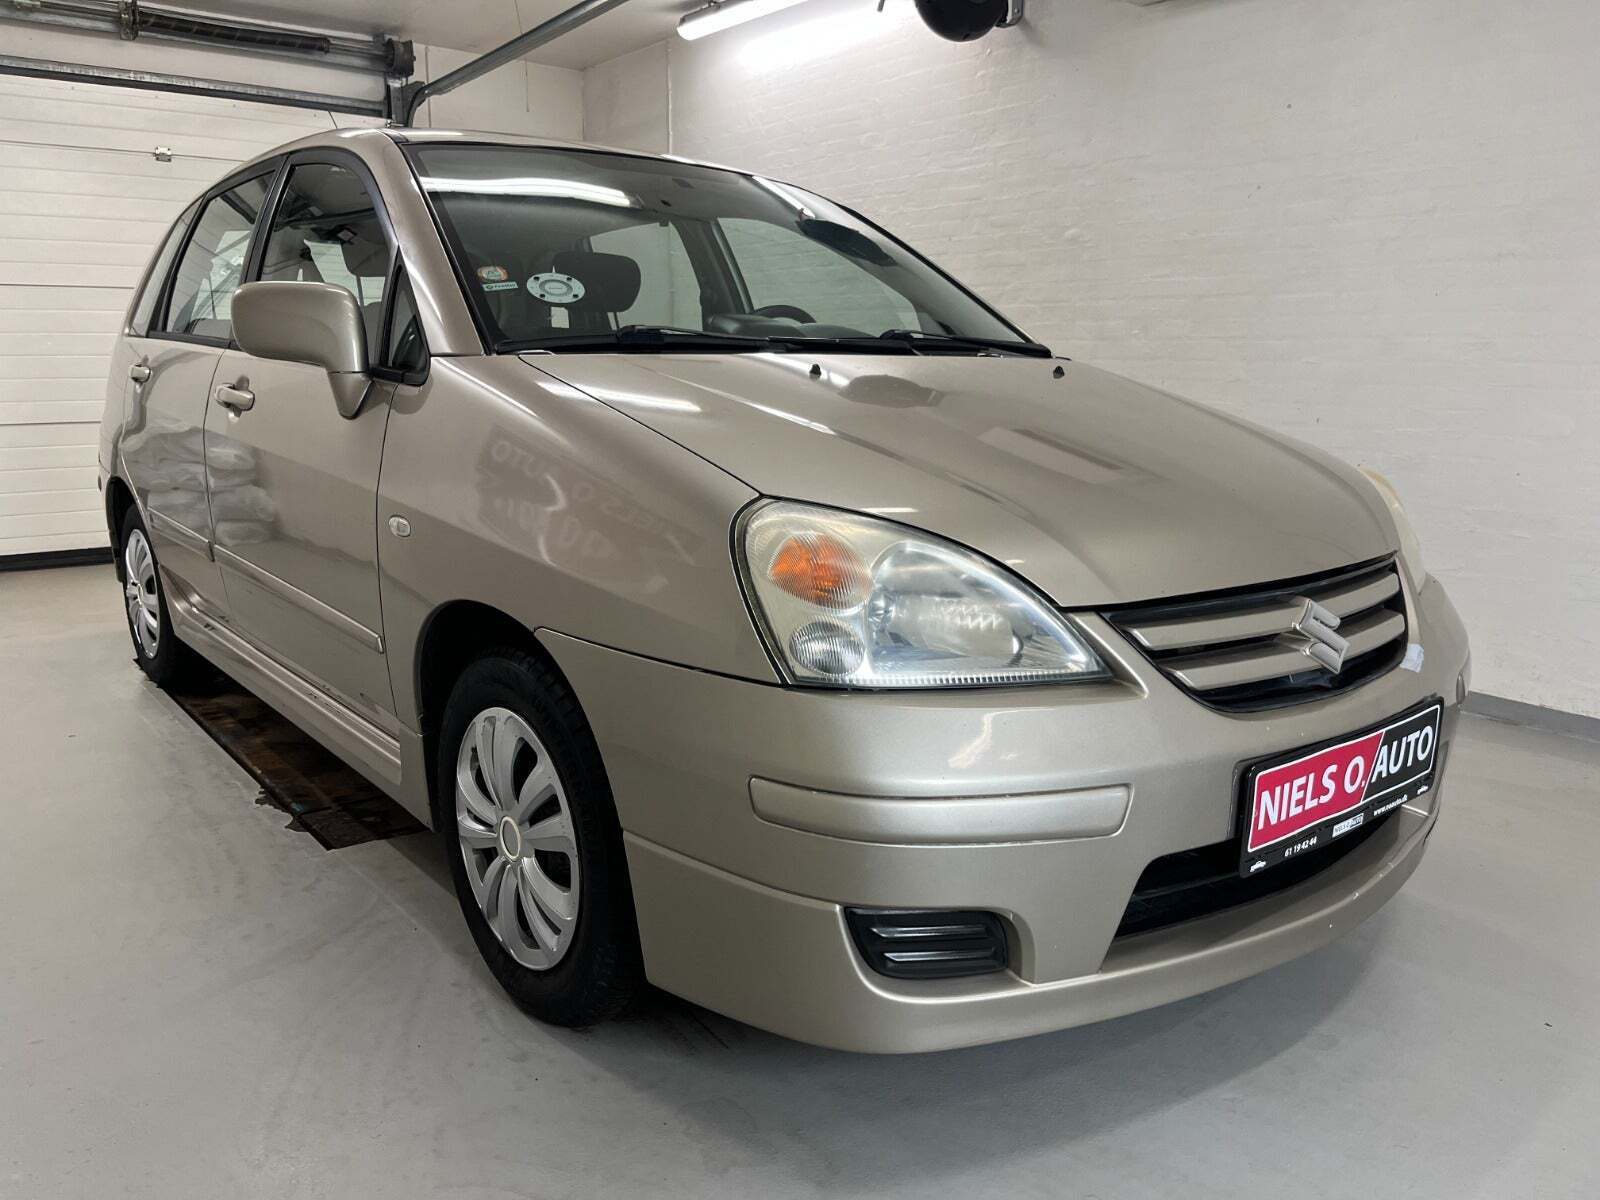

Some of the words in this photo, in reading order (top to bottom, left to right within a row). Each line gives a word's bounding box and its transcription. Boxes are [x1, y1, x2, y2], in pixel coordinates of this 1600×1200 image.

[1257, 764, 1338, 830] NIELS
[1344, 755, 1365, 794] O.
[1371, 725, 1433, 783] AUTO
